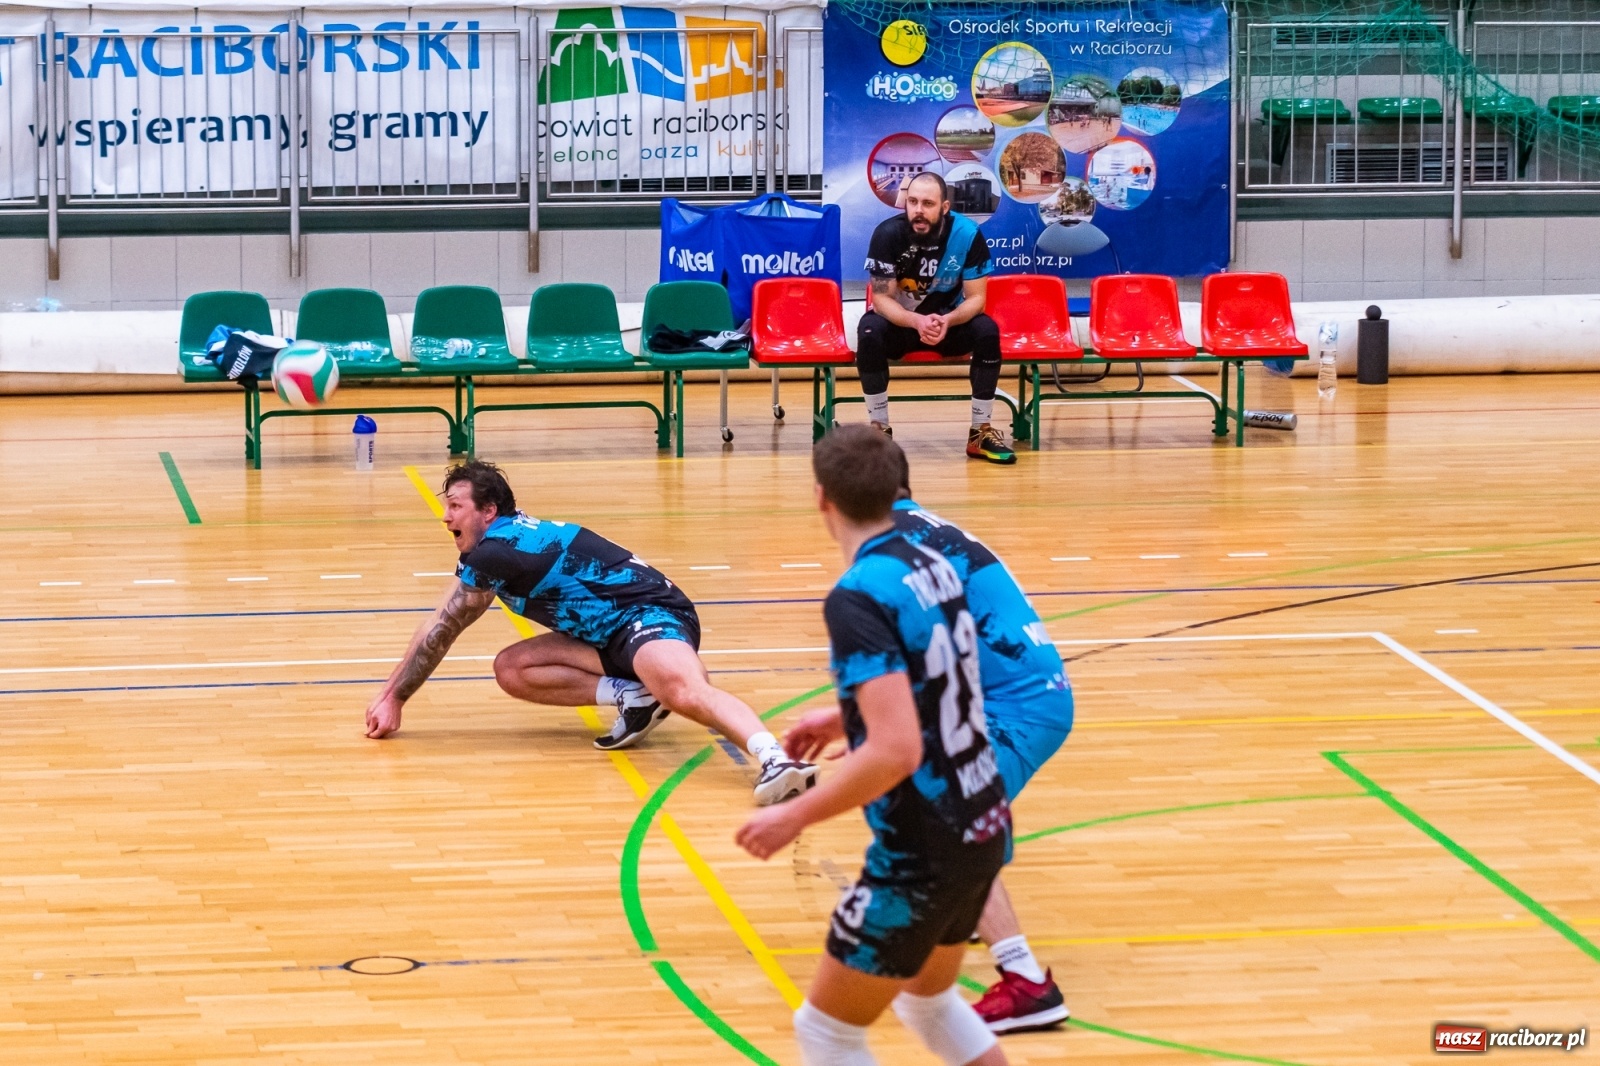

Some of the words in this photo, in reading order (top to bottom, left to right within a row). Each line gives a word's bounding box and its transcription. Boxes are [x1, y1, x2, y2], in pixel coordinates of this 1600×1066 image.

[949, 19, 1019, 34] Ośrodek
[1025, 19, 1080, 35] Sportu
[1085, 20, 1090, 33] i
[1095, 19, 1173, 36] Rekreacji
[41, 21, 480, 82] RACIBORSKI
[1070, 44, 1084, 55] w
[1091, 41, 1172, 55] Raciborzu
[328, 110, 489, 152] gramy
[652, 105, 790, 136] raciborski
[537, 146, 619, 163] zelona
[741, 250, 825, 276] molten
[919, 257, 938, 277] 26
